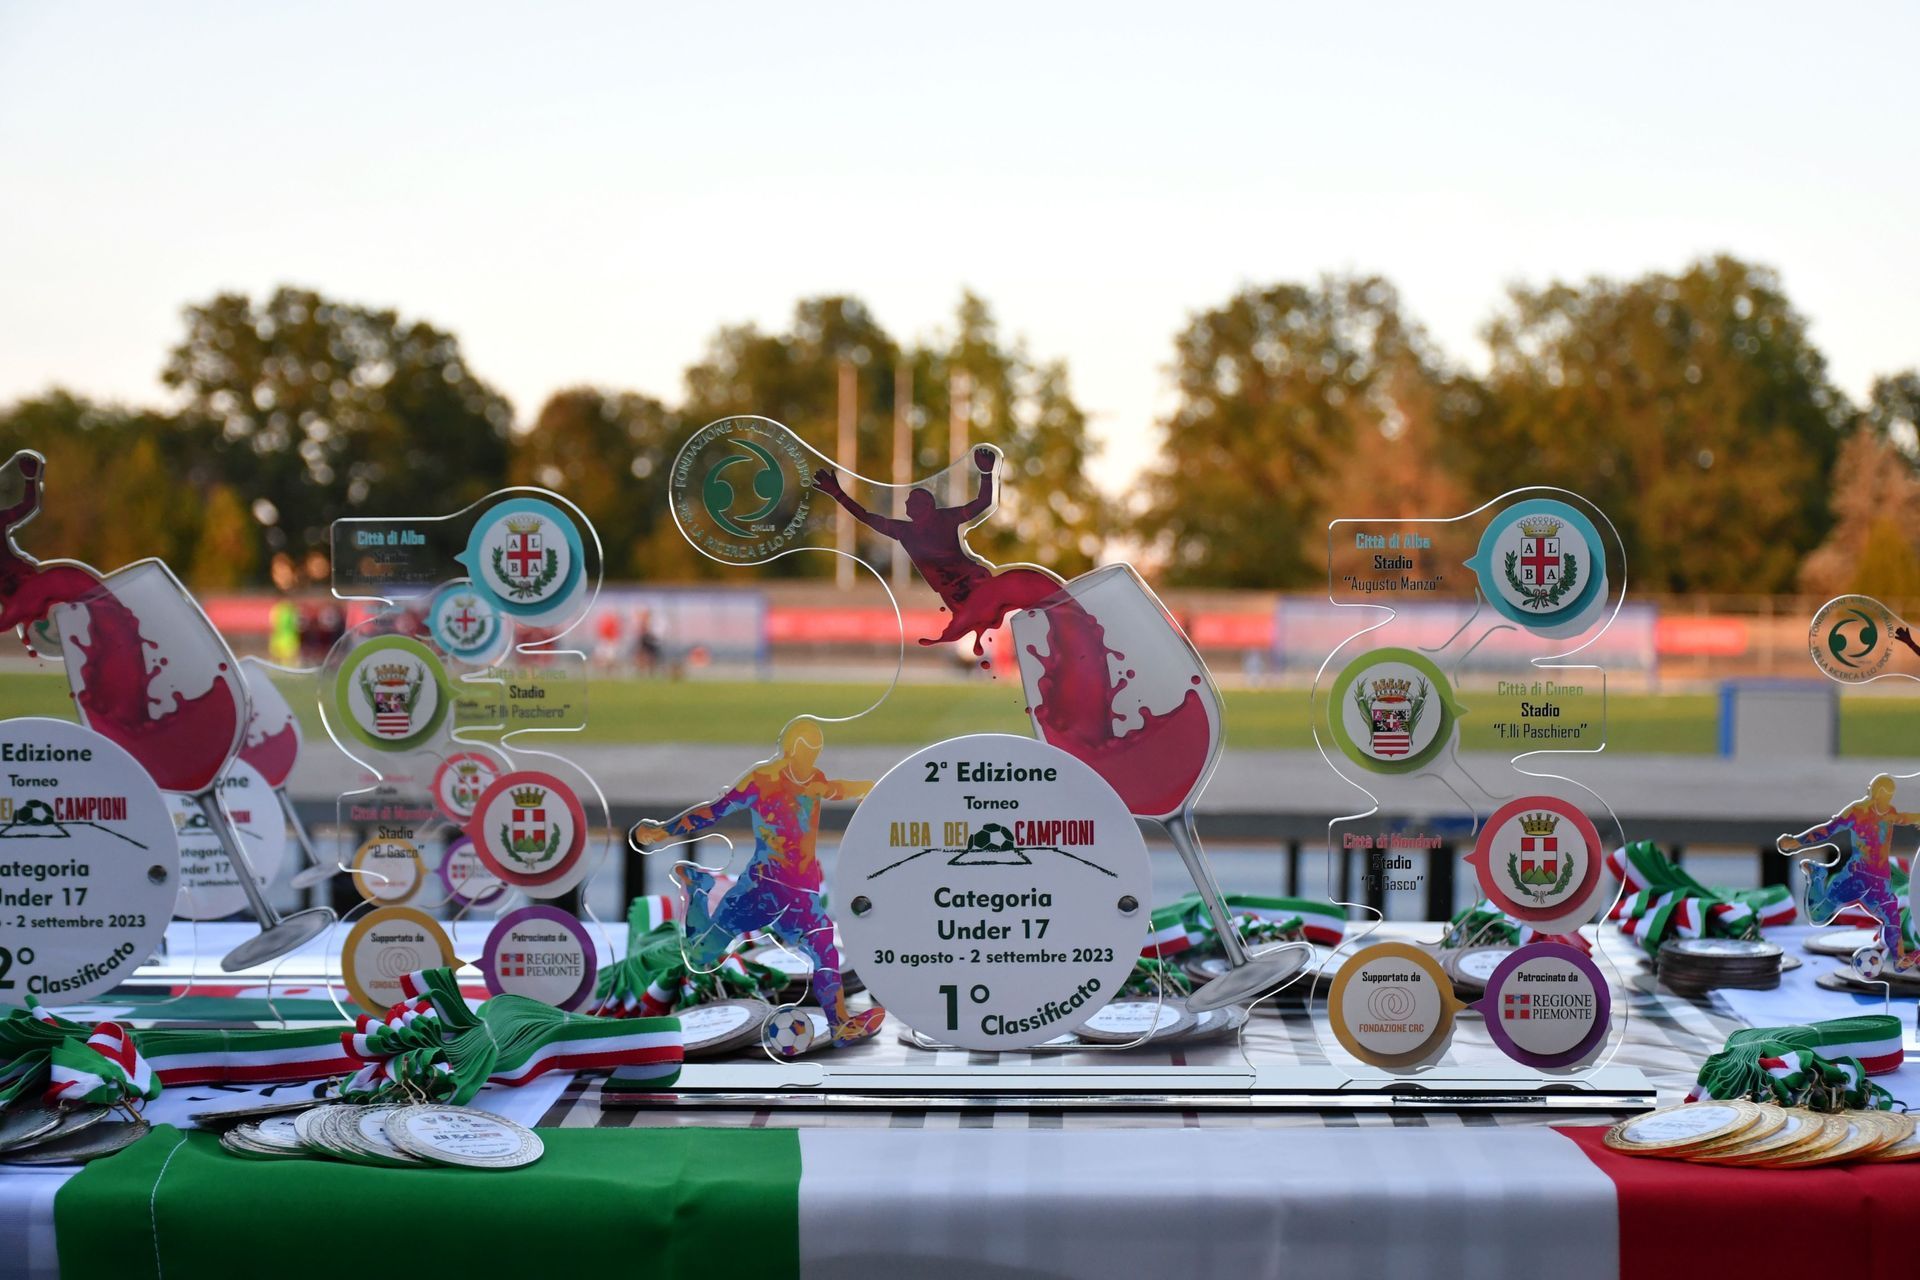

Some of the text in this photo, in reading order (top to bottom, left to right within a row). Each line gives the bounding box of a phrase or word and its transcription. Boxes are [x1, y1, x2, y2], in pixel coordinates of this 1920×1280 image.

[675, 419, 733, 488] FONDAZIONE
[776, 434, 786, 445] E
[759, 543, 768, 555] E
[767, 535, 785, 548] LO
[783, 501, 810, 539] SPORT
[356, 530, 426, 545] Città di Alba
[509, 539, 519, 549] A
[1356, 533, 1431, 549] Città di Alba
[1524, 543, 1557, 554] A L
[511, 563, 540, 573] B A
[1374, 555, 1413, 570] Stadio
[1525, 569, 1557, 580] B A
[509, 685, 545, 699] Stadio
[1498, 682, 1584, 696] Città di Cuneo
[1521, 703, 1560, 717] Stadio
[1, 743, 93, 762] Edizione
[957, 762, 1057, 782] Edizione
[8, 774, 59, 788] Torneo
[0, 797, 127, 820] EI CAMPIONI
[963, 796, 1019, 810] Torneo
[378, 826, 414, 840] Stadio
[890, 820, 1094, 847] ALBA DEI CAMPIONI
[1343, 833, 1373, 849] Città
[1377, 833, 1388, 849] di
[181, 862, 230, 875] nder 17
[1372, 854, 1412, 870] Stadio
[0, 859, 90, 882] ategoria
[62, 888, 88, 906] 17
[934, 887, 1052, 912] Categoria
[16, 915, 26, 928] 2
[31, 915, 104, 928] settembre
[108, 915, 146, 928] 2023
[937, 919, 1050, 940] Under 17
[371, 932, 424, 944] Supportato da
[512, 933, 568, 943] Patrocinato da
[526, 953, 580, 965] REGIONE
[874, 950, 895, 964] 30
[900, 950, 954, 967] agosto
[970, 950, 981, 963] 2
[986, 948, 1067, 964] settembre
[1072, 948, 1114, 963] 2023
[27, 942, 135, 994] Classificato
[526, 966, 580, 977] PIEMONTE
[1362, 972, 1421, 984] Supportato da
[1517, 972, 1578, 983] Patrocinato da
[981, 977, 1101, 1036] Classificato
[1532, 994, 1592, 1007] REGIONE
[1532, 1008, 1592, 1020] PIEMONTE
[1359, 1024, 1424, 1033] FONDAZIONE CRC
